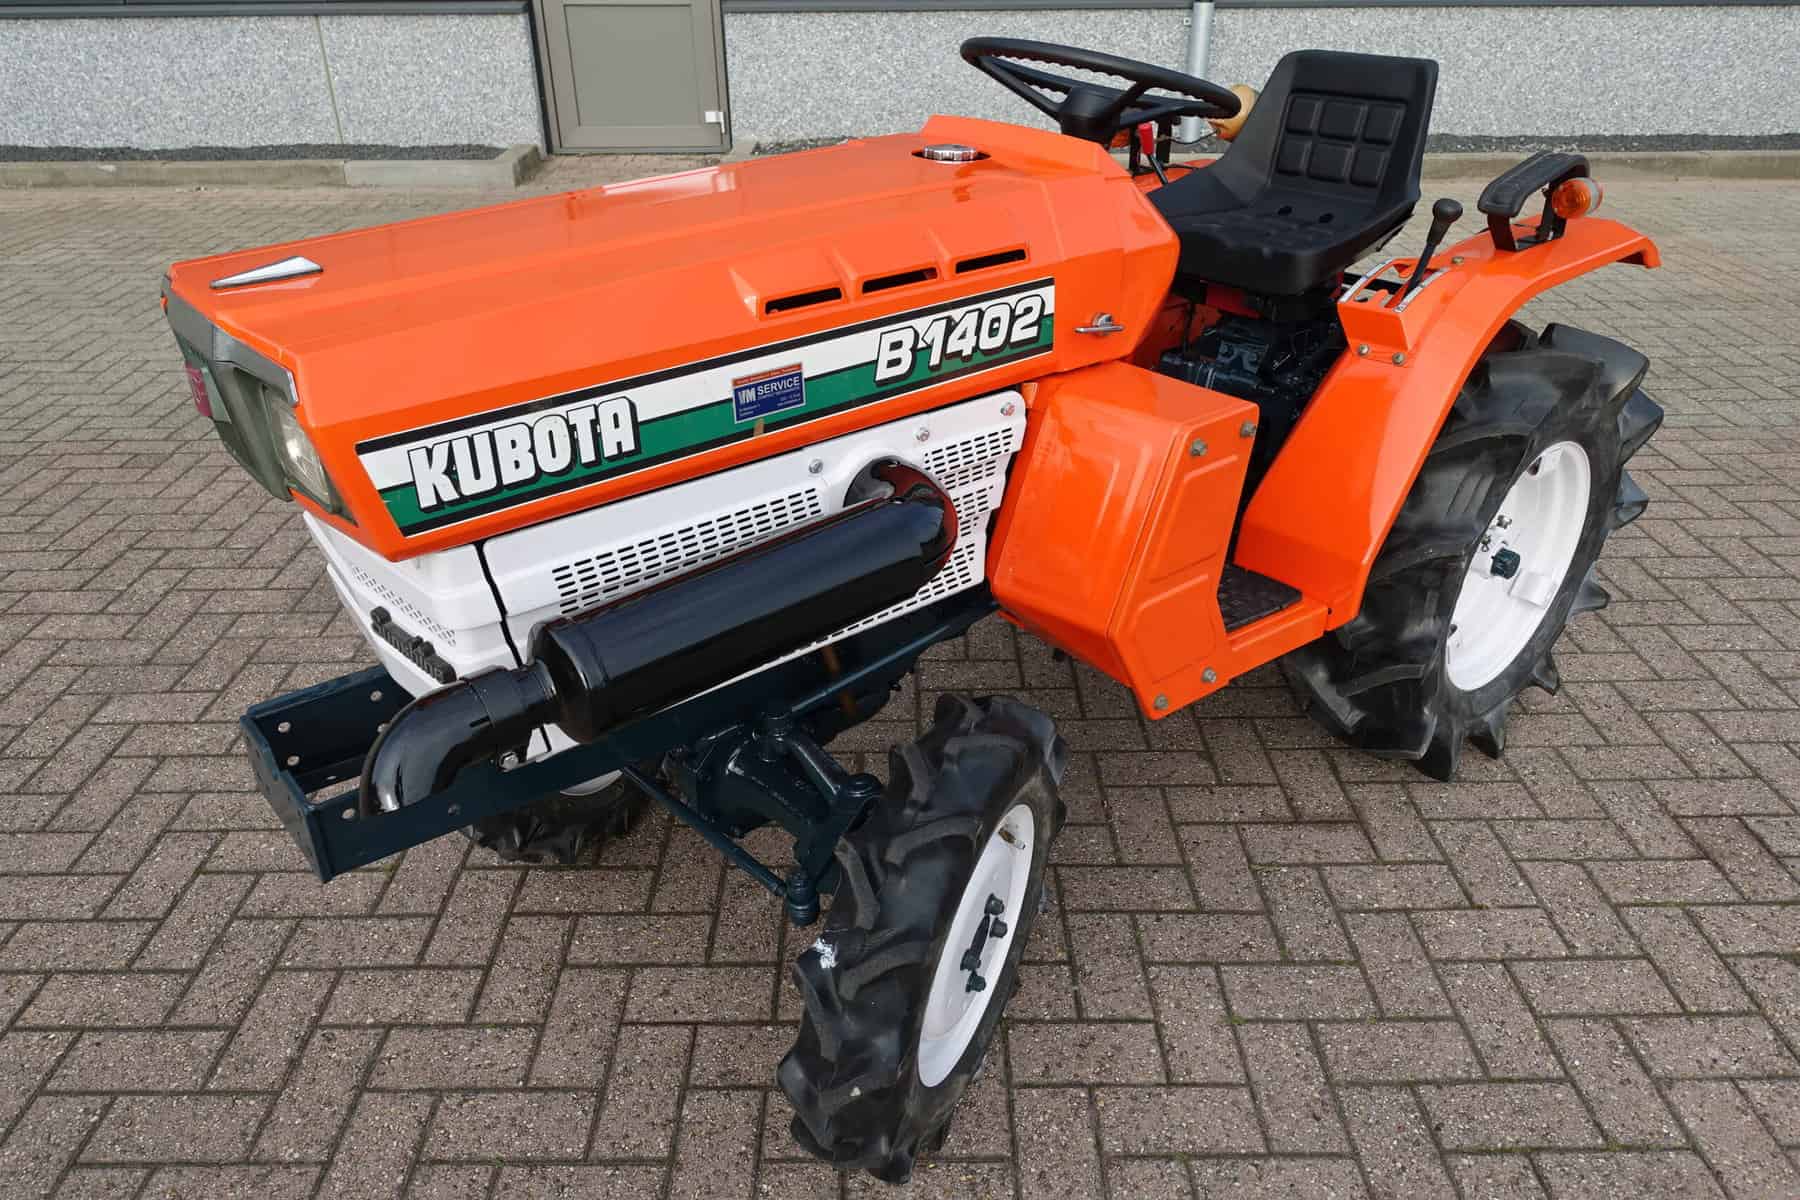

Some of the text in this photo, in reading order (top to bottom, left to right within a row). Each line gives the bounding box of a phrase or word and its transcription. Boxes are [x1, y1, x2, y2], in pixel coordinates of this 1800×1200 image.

[757, 375, 801, 396] SERVICE
[874, 294, 1046, 387] B1402
[407, 396, 640, 512] KUBOTA
